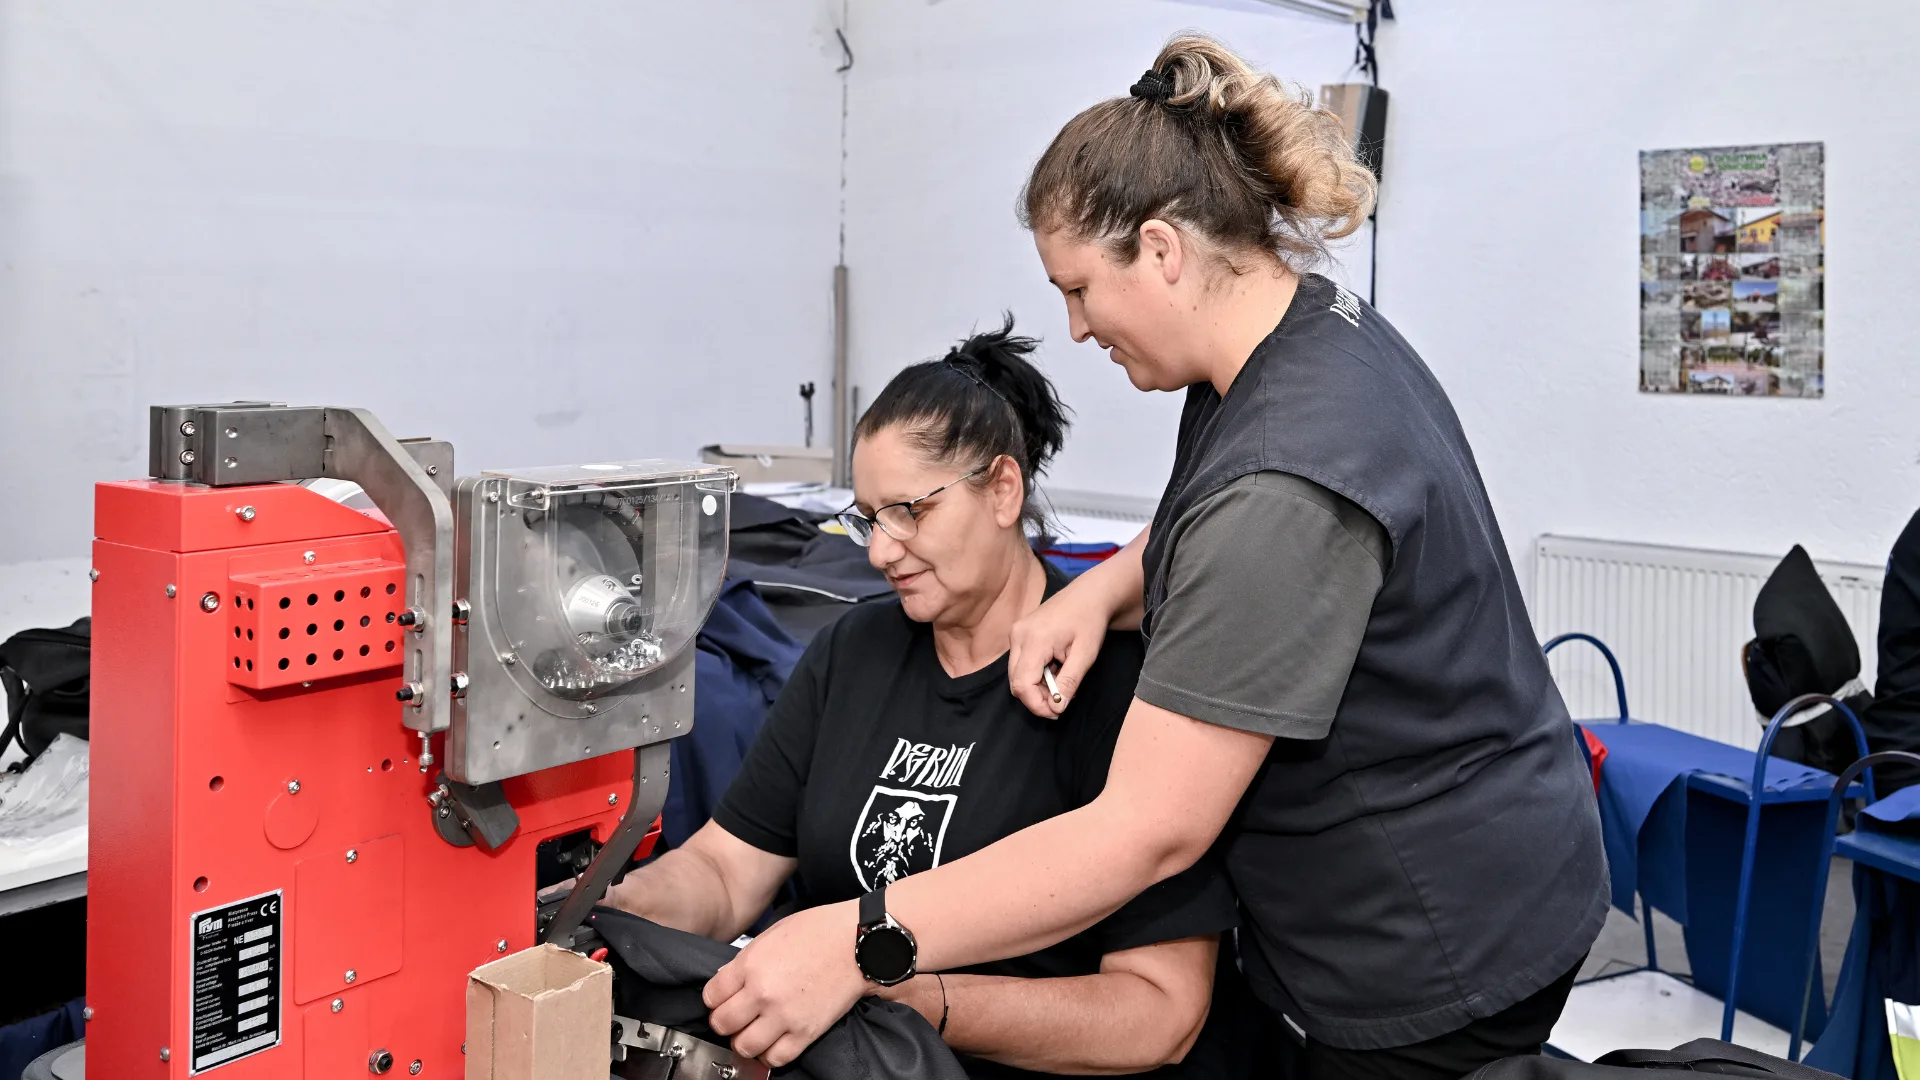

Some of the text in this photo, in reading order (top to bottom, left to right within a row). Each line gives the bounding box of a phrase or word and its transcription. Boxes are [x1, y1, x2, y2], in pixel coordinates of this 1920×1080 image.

[879, 737, 976, 788] PERUN
[199, 917, 223, 935] Prym
[233, 934, 244, 945] NE
